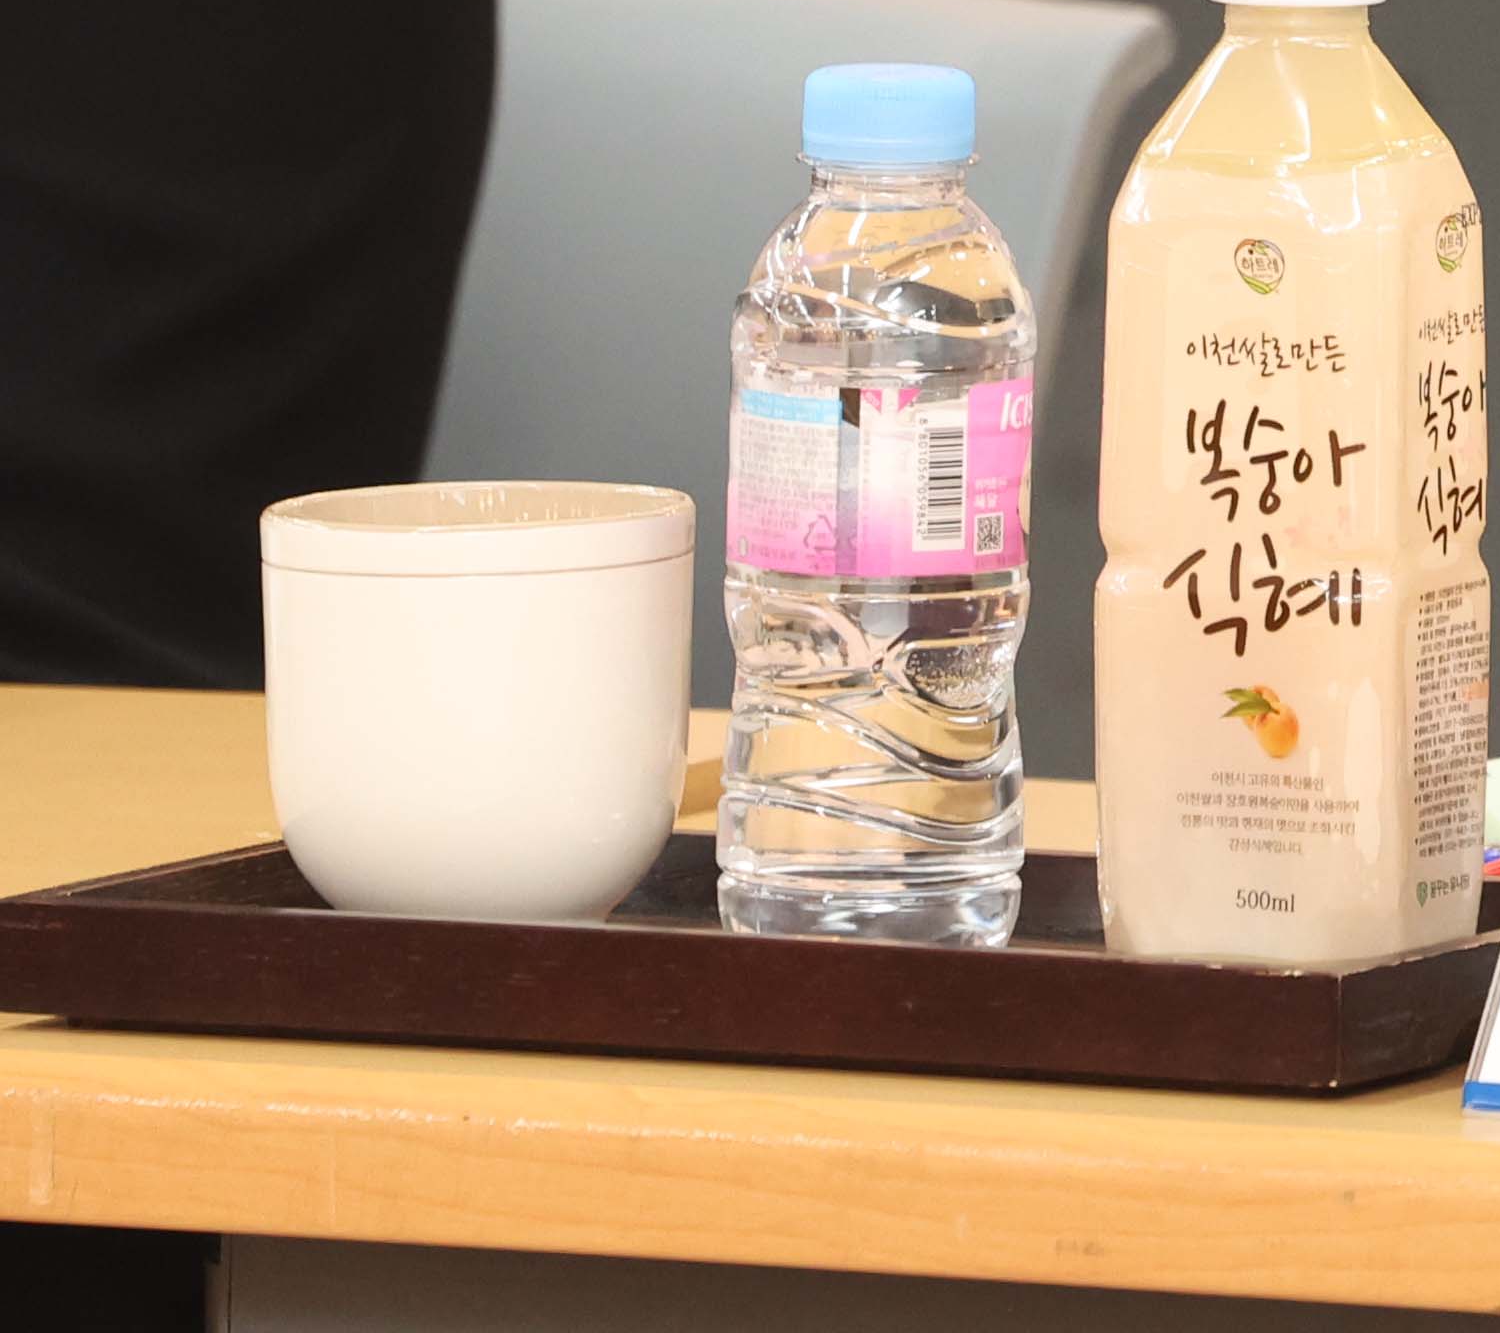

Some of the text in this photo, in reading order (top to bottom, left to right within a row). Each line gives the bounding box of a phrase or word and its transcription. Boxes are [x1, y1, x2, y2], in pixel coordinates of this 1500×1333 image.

[1186, 398, 1366, 523] 복숭아
[1162, 532, 1362, 658] 식혜
[1236, 889, 1295, 913] 500ml
